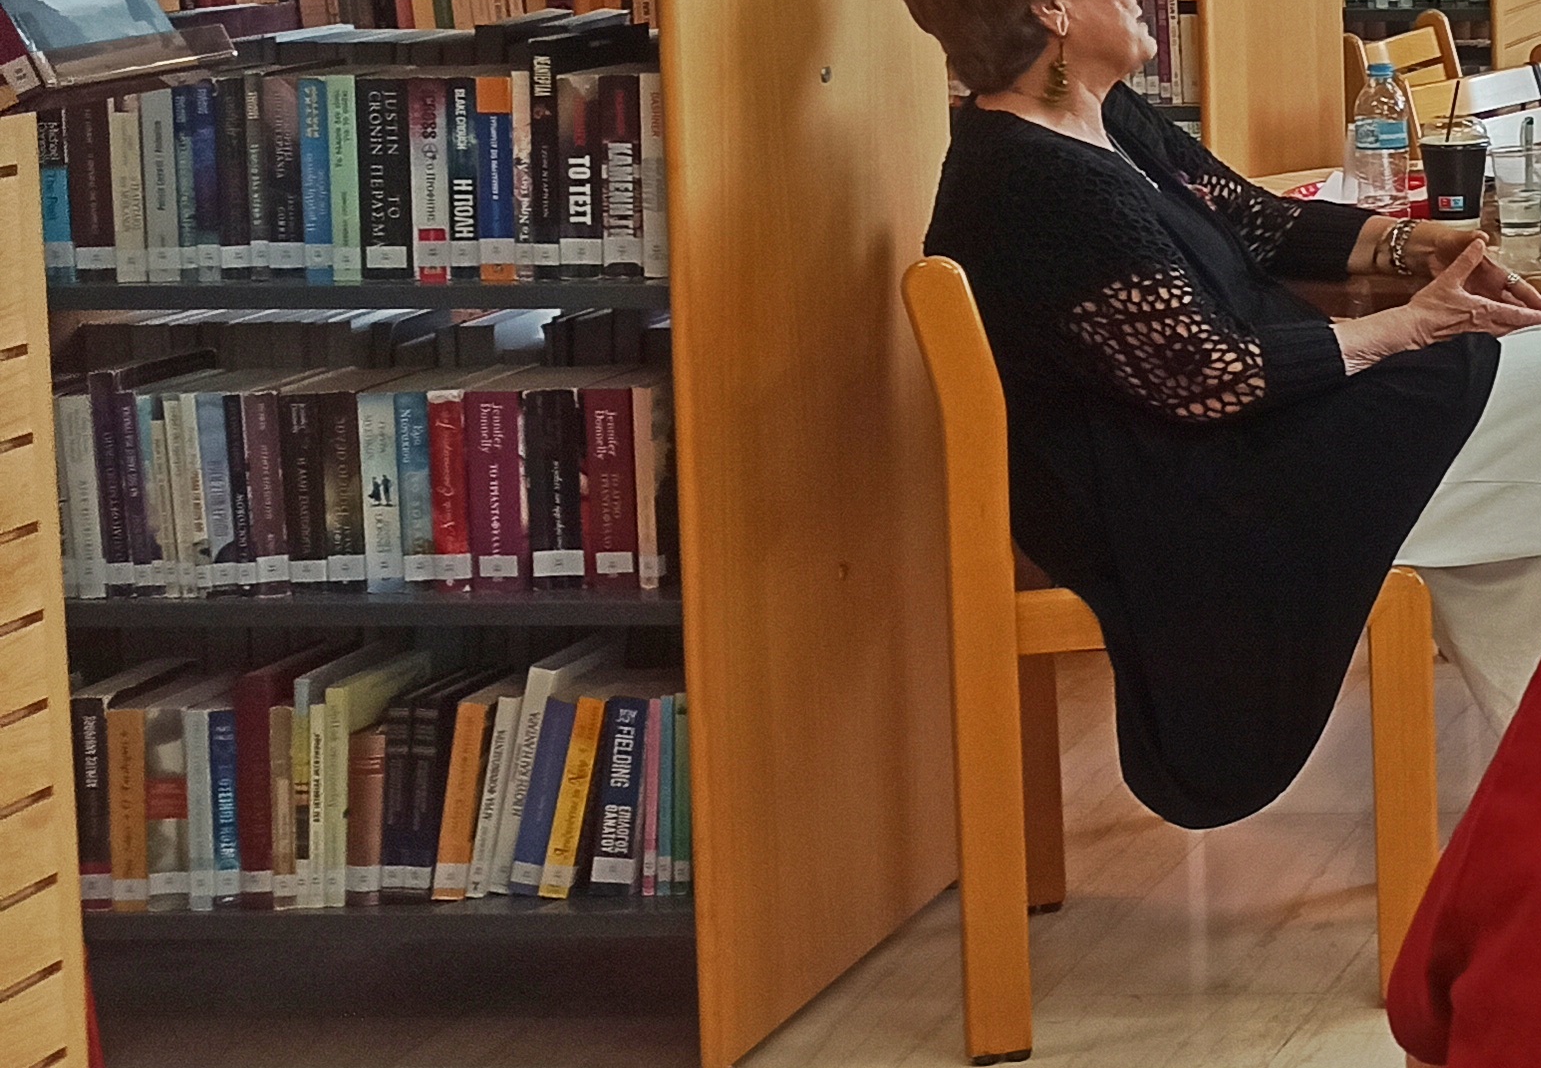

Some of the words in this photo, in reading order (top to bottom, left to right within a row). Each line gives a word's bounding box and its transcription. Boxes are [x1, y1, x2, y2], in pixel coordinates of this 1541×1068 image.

[368, 90, 384, 156] CRONIN
[382, 90, 400, 156] JUSTIN
[453, 178, 473, 192] Η
[567, 154, 591, 180] ΤΟ
[607, 142, 635, 216] ΚΑΜΕΝΗ
[387, 196, 401, 219] ΤΟ
[453, 193, 475, 238] ΠΟΛΗ
[568, 183, 592, 226] ΤΕΣΤ
[478, 402, 493, 454] Donnelly
[491, 402, 505, 451] Jennifer
[593, 409, 607, 461] Donnelly
[605, 410, 619, 457] Jennifer
[488, 462, 500, 479] ΤΟ
[609, 724, 636, 789] FIELDING
[600, 803, 618, 854] ΘΑΝΑΤΟΥ
[615, 805, 632, 854] ΕΠΙΛΟΓΟΣ
